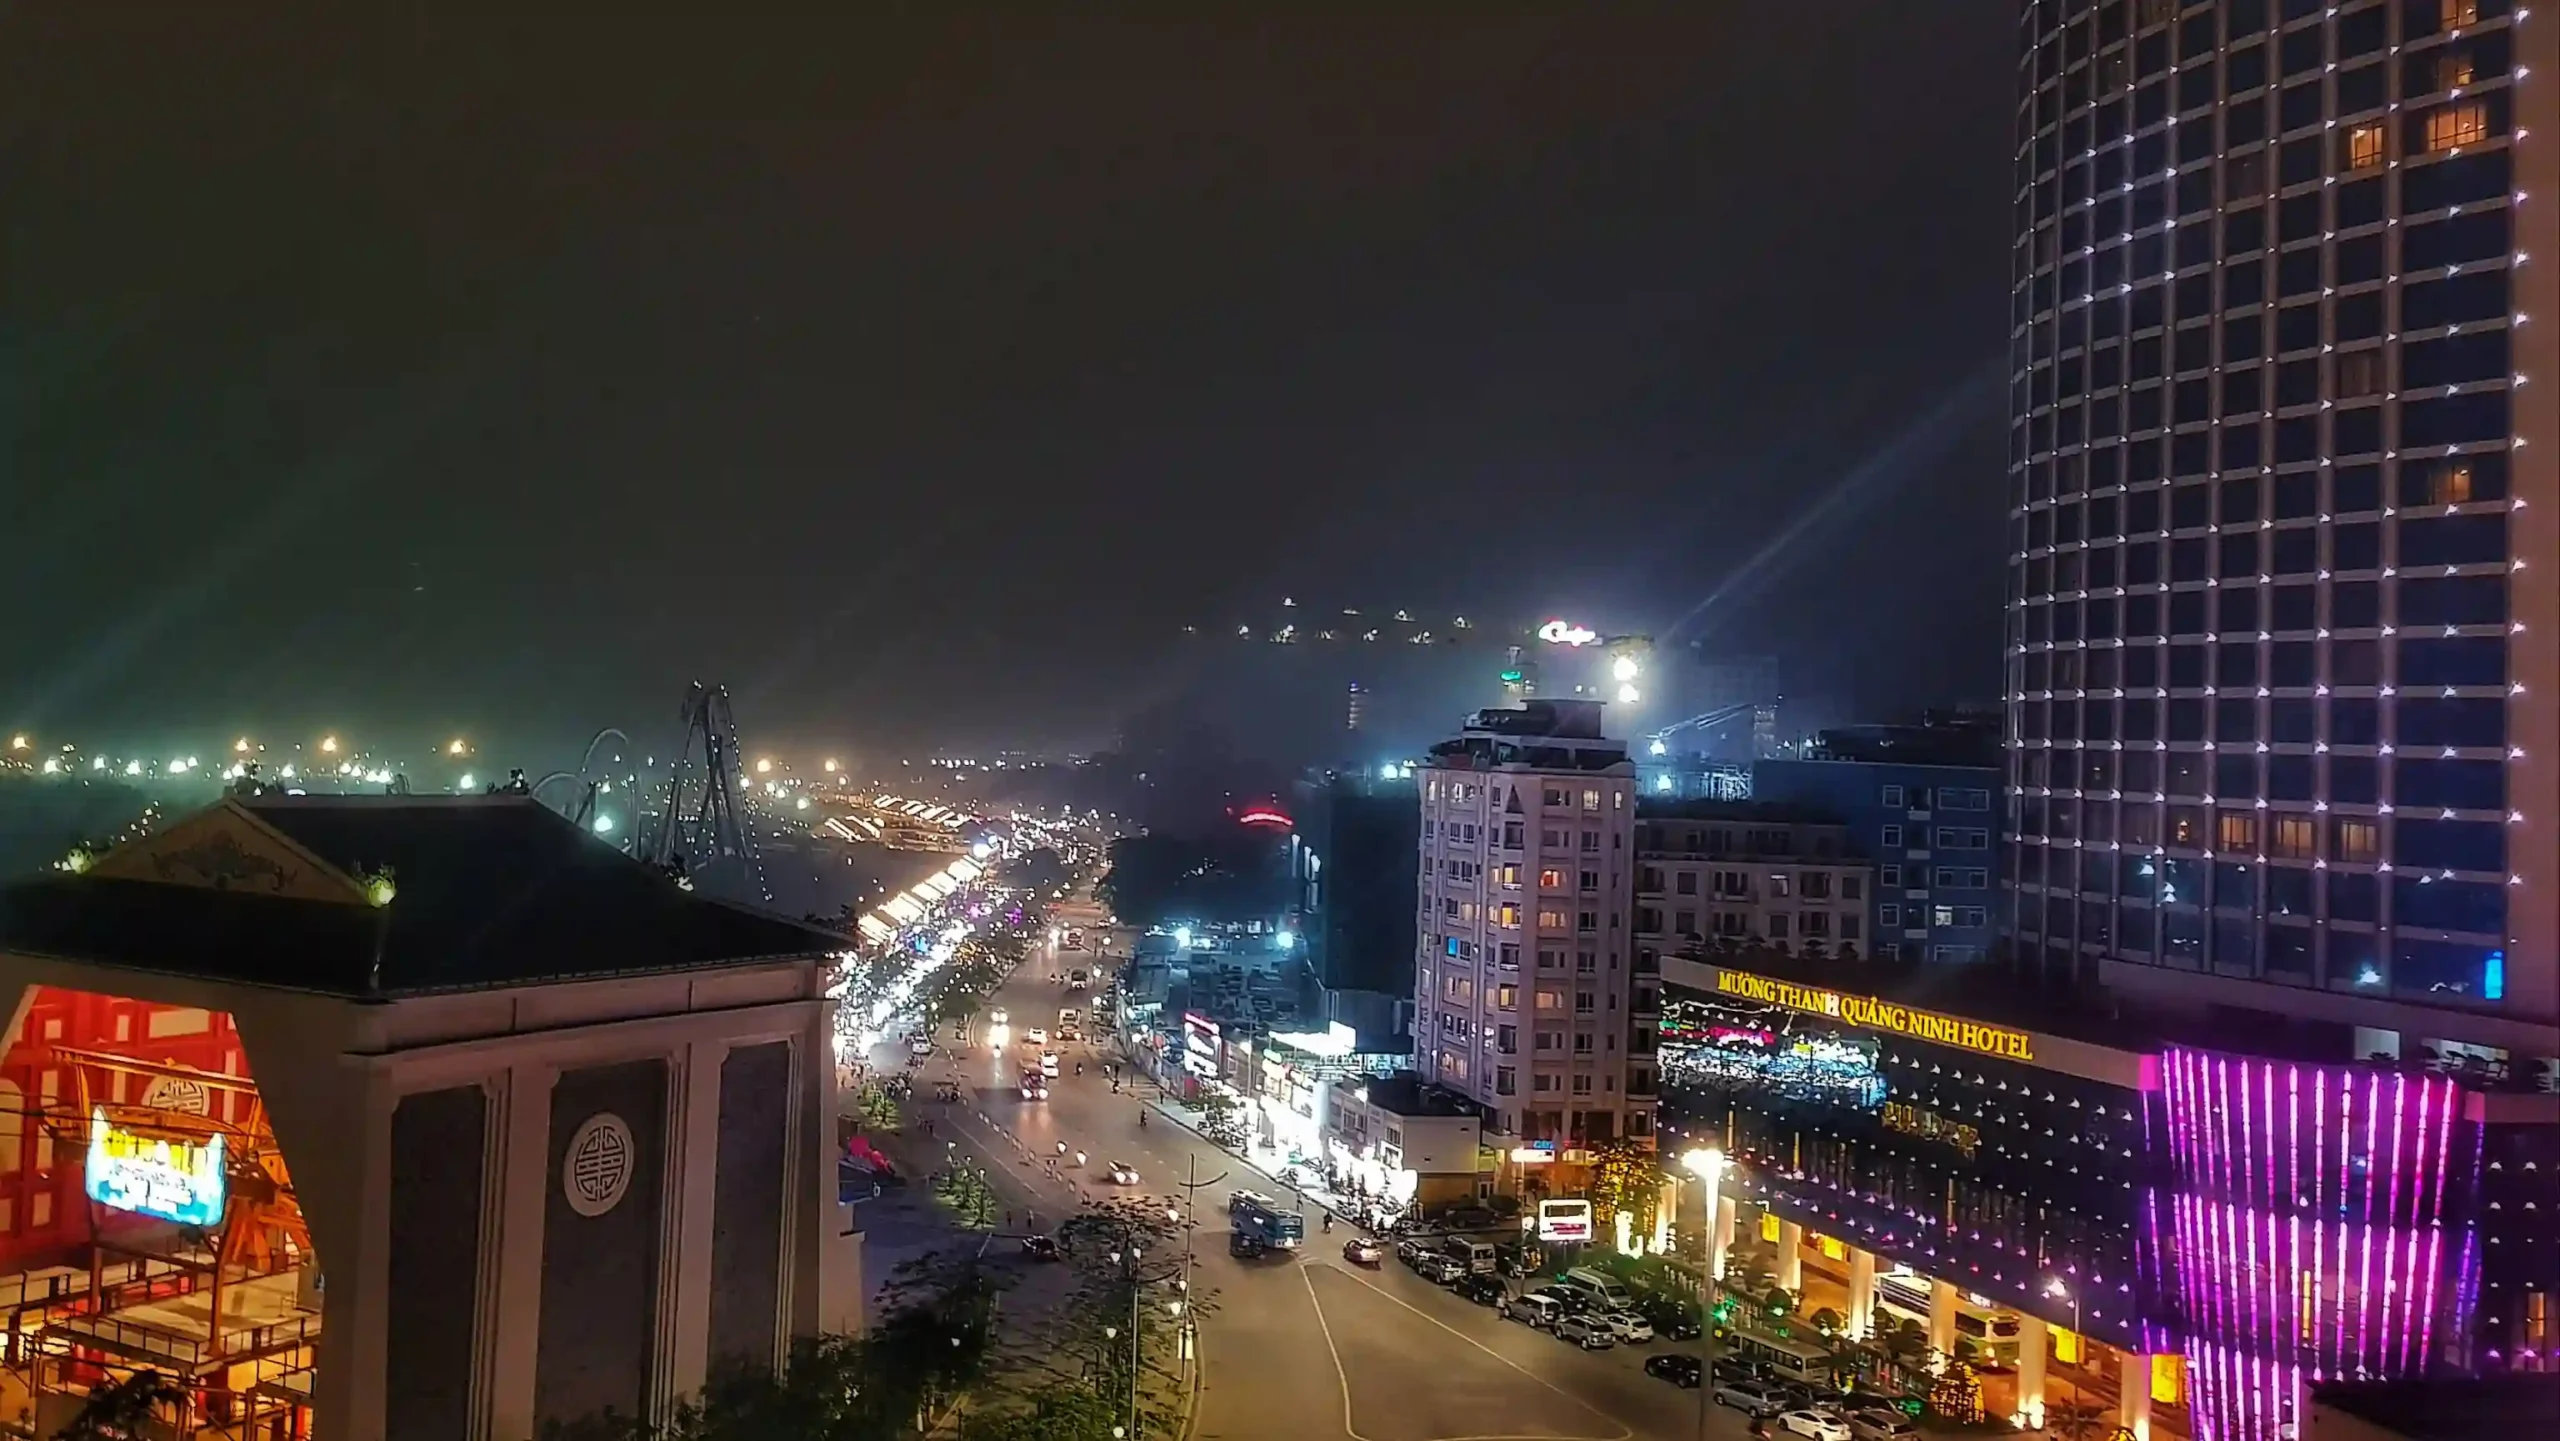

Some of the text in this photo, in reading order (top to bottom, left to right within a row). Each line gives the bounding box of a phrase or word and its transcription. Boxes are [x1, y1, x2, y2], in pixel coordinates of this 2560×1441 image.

[1777, 984, 1840, 1017] THANH
[1907, 1011, 1959, 1044] NINH
[1961, 1023, 2033, 1060] HOTEL
